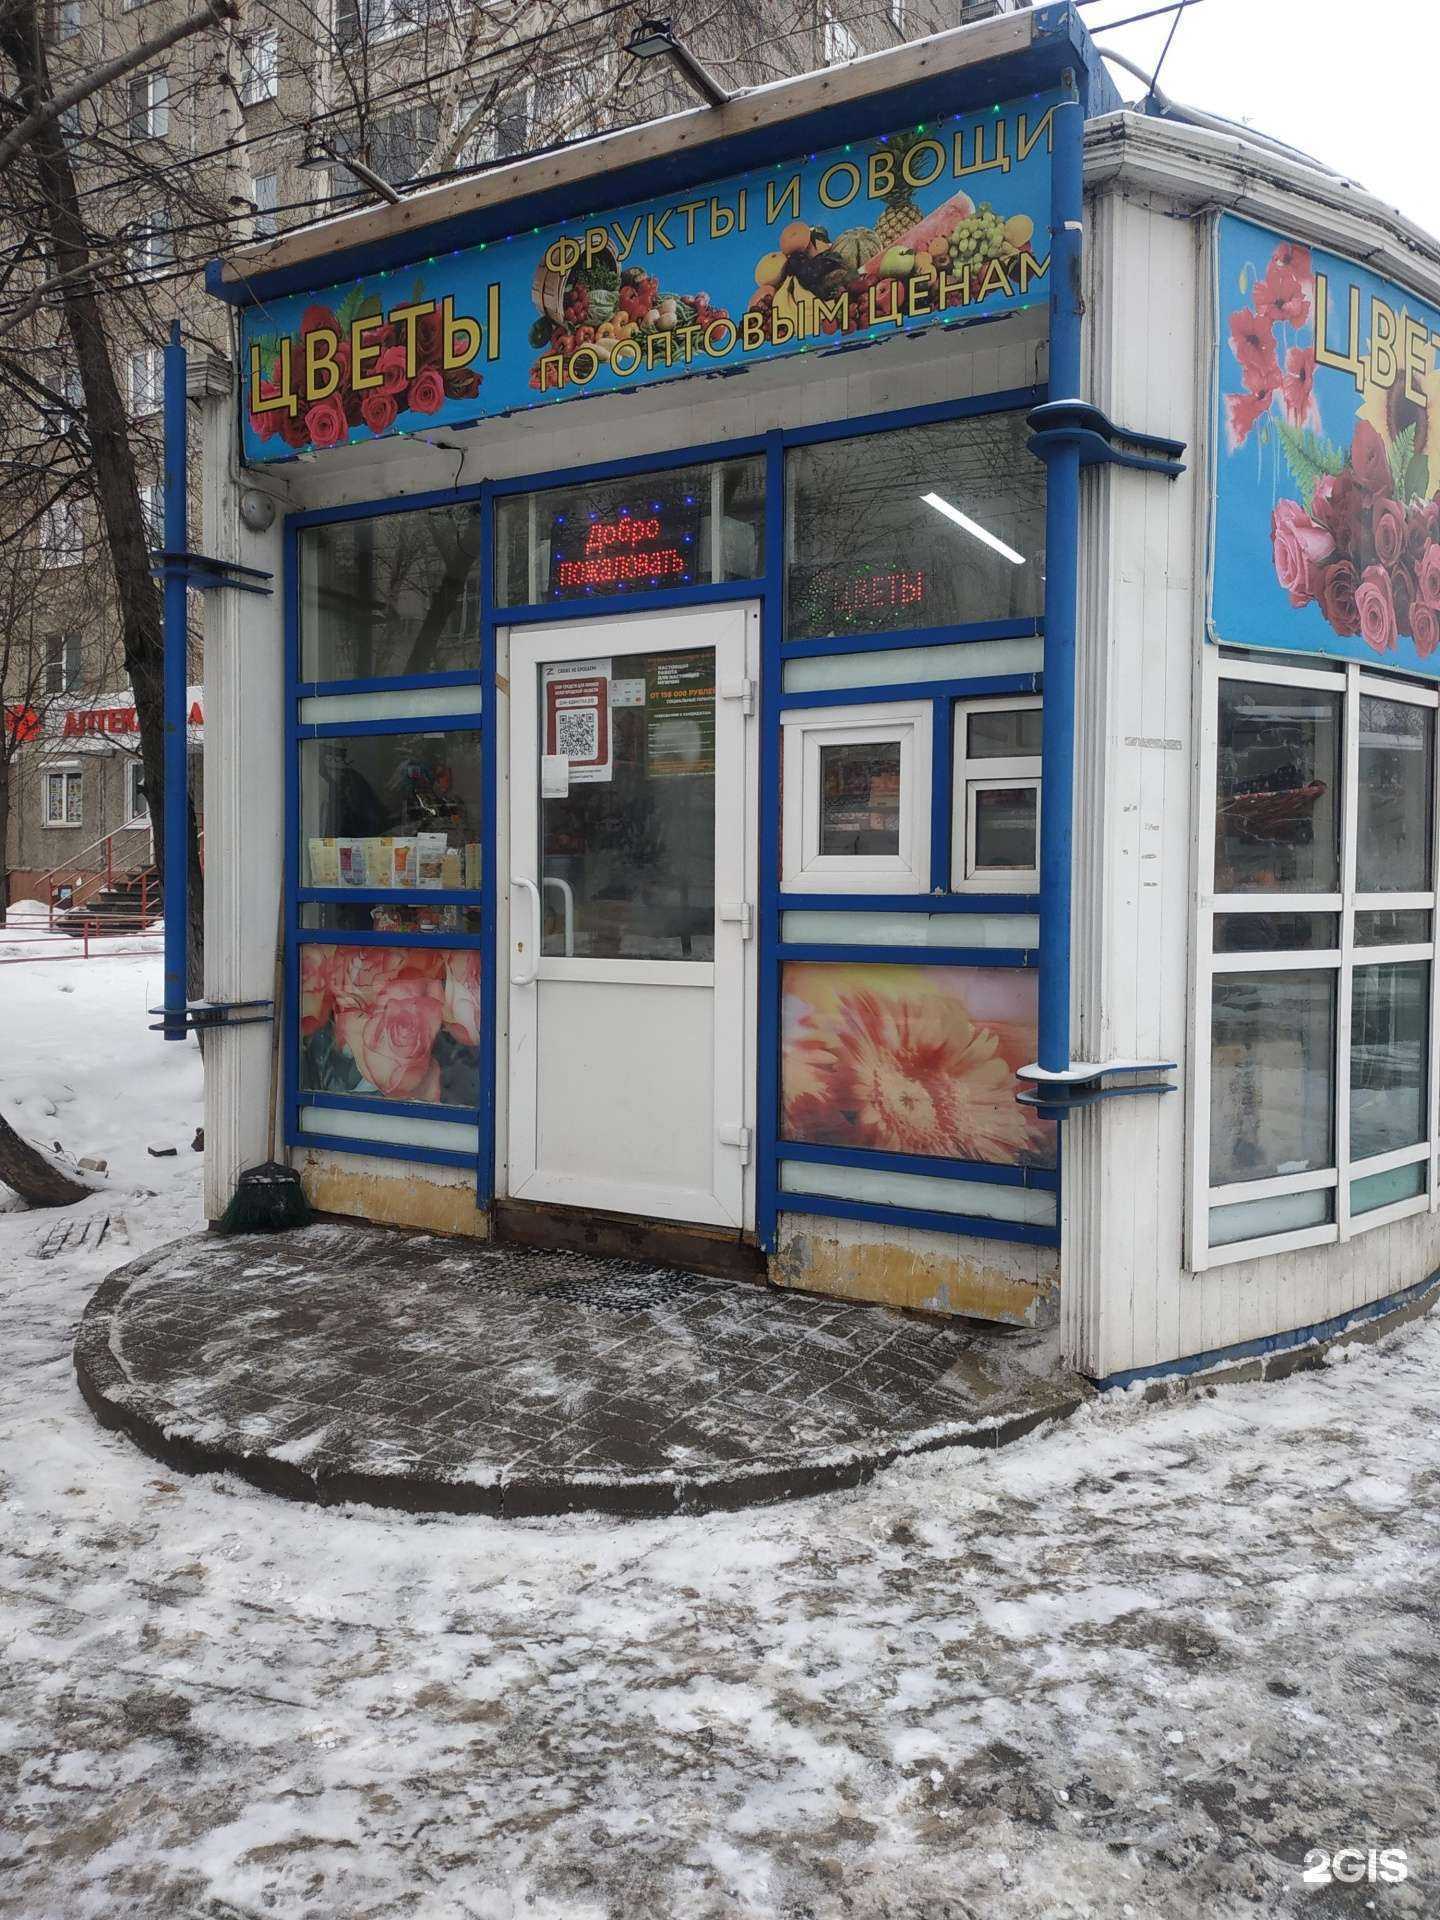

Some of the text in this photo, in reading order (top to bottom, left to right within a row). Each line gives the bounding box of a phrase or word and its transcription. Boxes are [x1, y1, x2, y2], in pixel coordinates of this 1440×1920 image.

[545, 104, 1054, 277] ФРУКТЫ И ОВОЩИ
[249, 281, 502, 418] ЦВЕТЫ
[540, 250, 1051, 393] ПО ОПТОВЫМ ЦЕНАМ
[1314, 271, 1440, 409] ЦВЕ
[833, 570, 924, 617] ЦВЕТЫ
